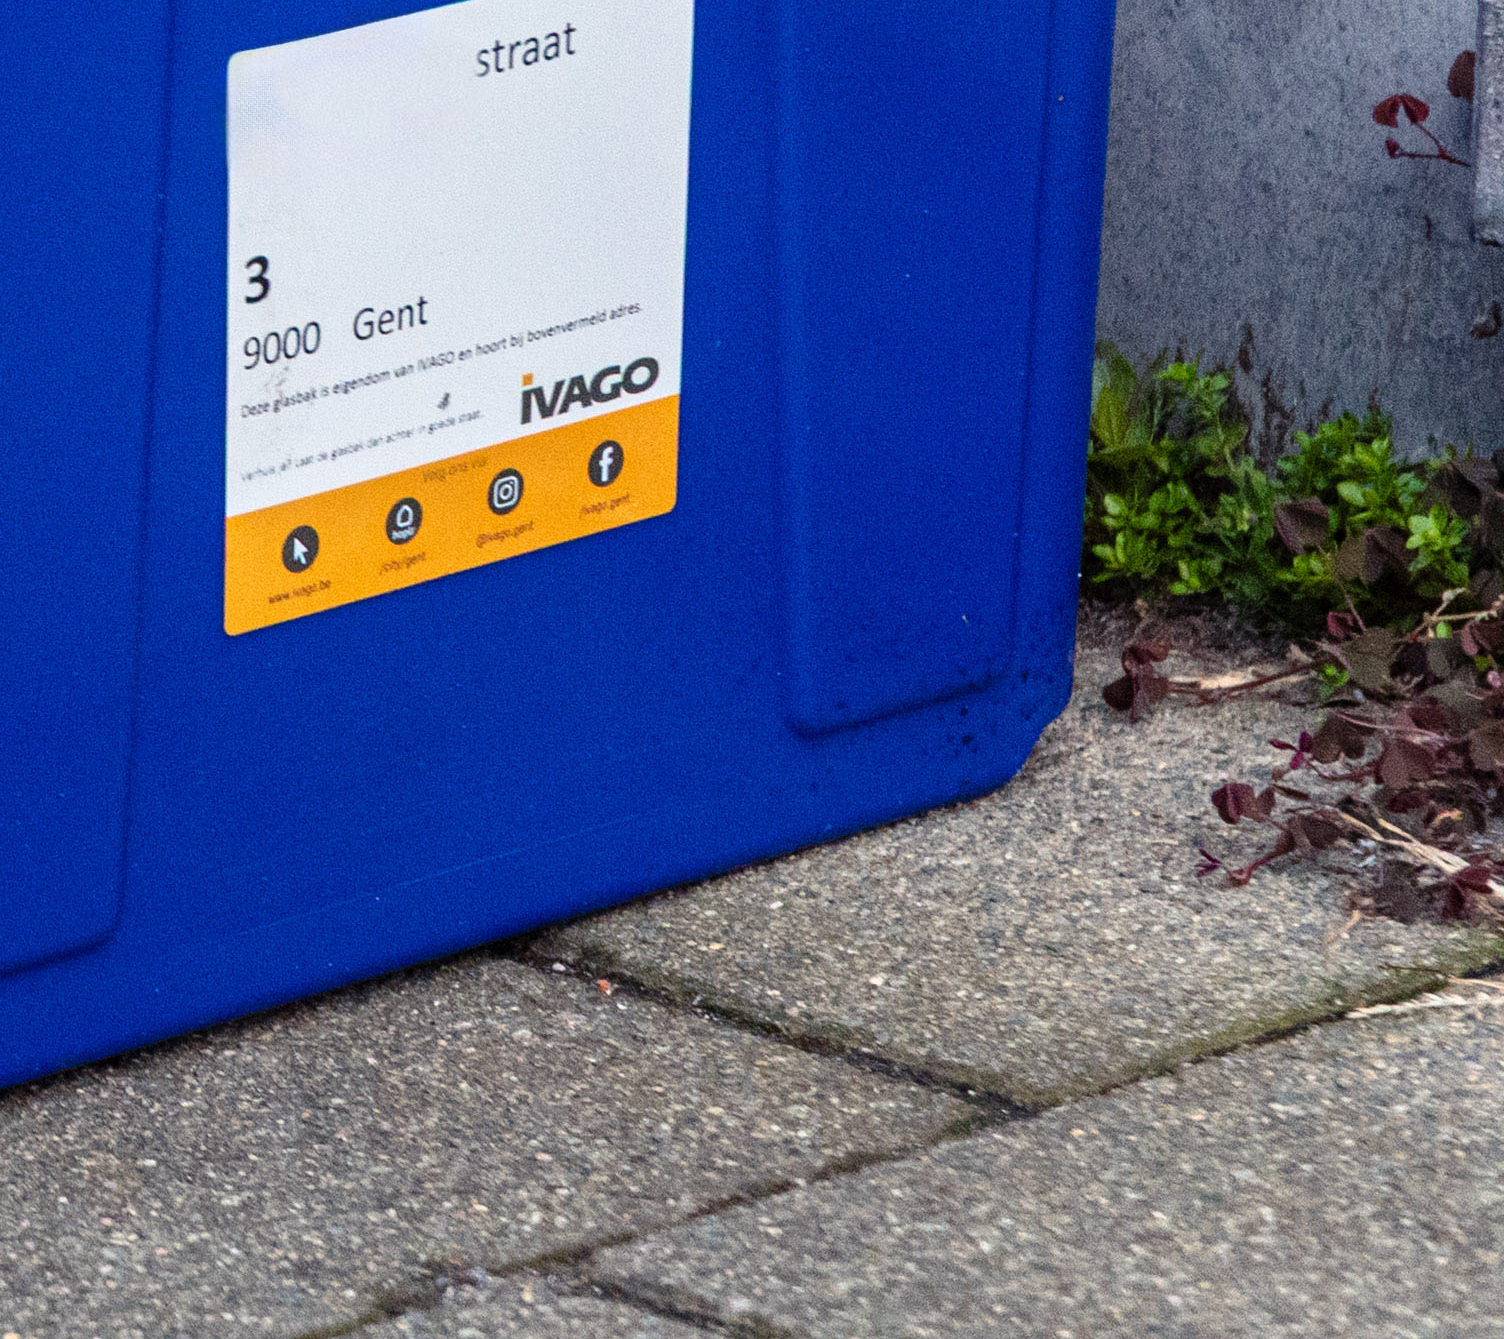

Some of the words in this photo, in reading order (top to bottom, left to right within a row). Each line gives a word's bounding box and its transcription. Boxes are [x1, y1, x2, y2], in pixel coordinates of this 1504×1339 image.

[476, 22, 577, 77] straat
[245, 255, 270, 304] 3
[241, 401, 270, 418] Deze
[332, 371, 391, 394] eigendom
[394, 364, 414, 378] van
[458, 347, 473, 361] en
[475, 337, 507, 356] hoort
[510, 332, 524, 348] bij
[527, 309, 607, 342] bovenvermeld
[244, 321, 321, 370] 9000
[353, 296, 428, 340] Gent
